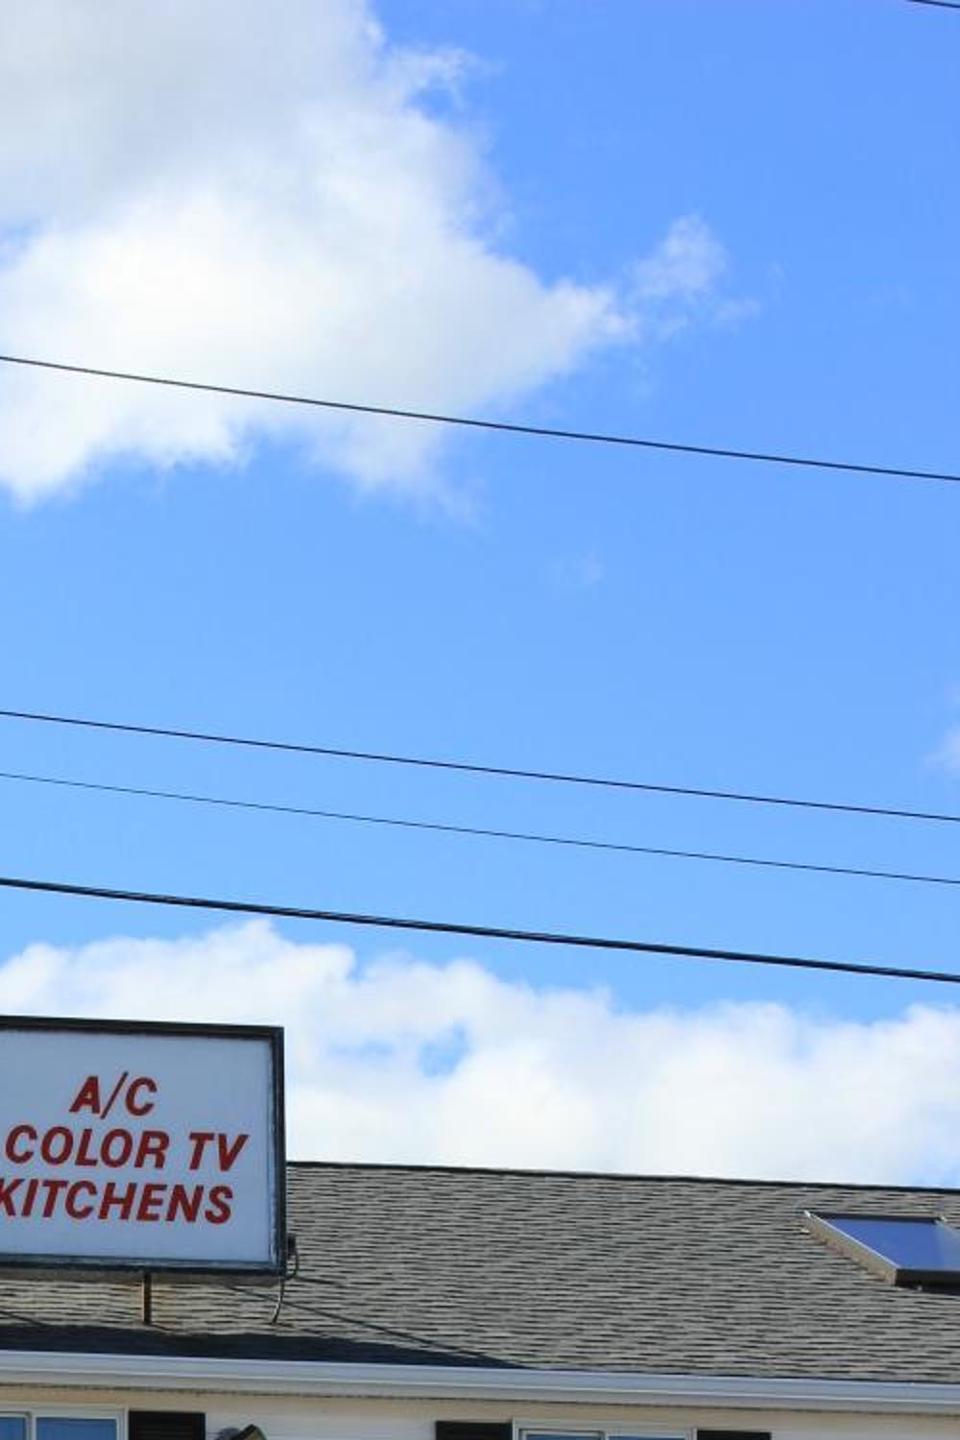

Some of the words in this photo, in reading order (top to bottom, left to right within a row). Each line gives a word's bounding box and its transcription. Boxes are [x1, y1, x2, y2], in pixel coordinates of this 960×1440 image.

[68, 1071, 158, 1119] A/C
[4, 1124, 171, 1170] COLOR
[189, 1132, 250, 1173] TV
